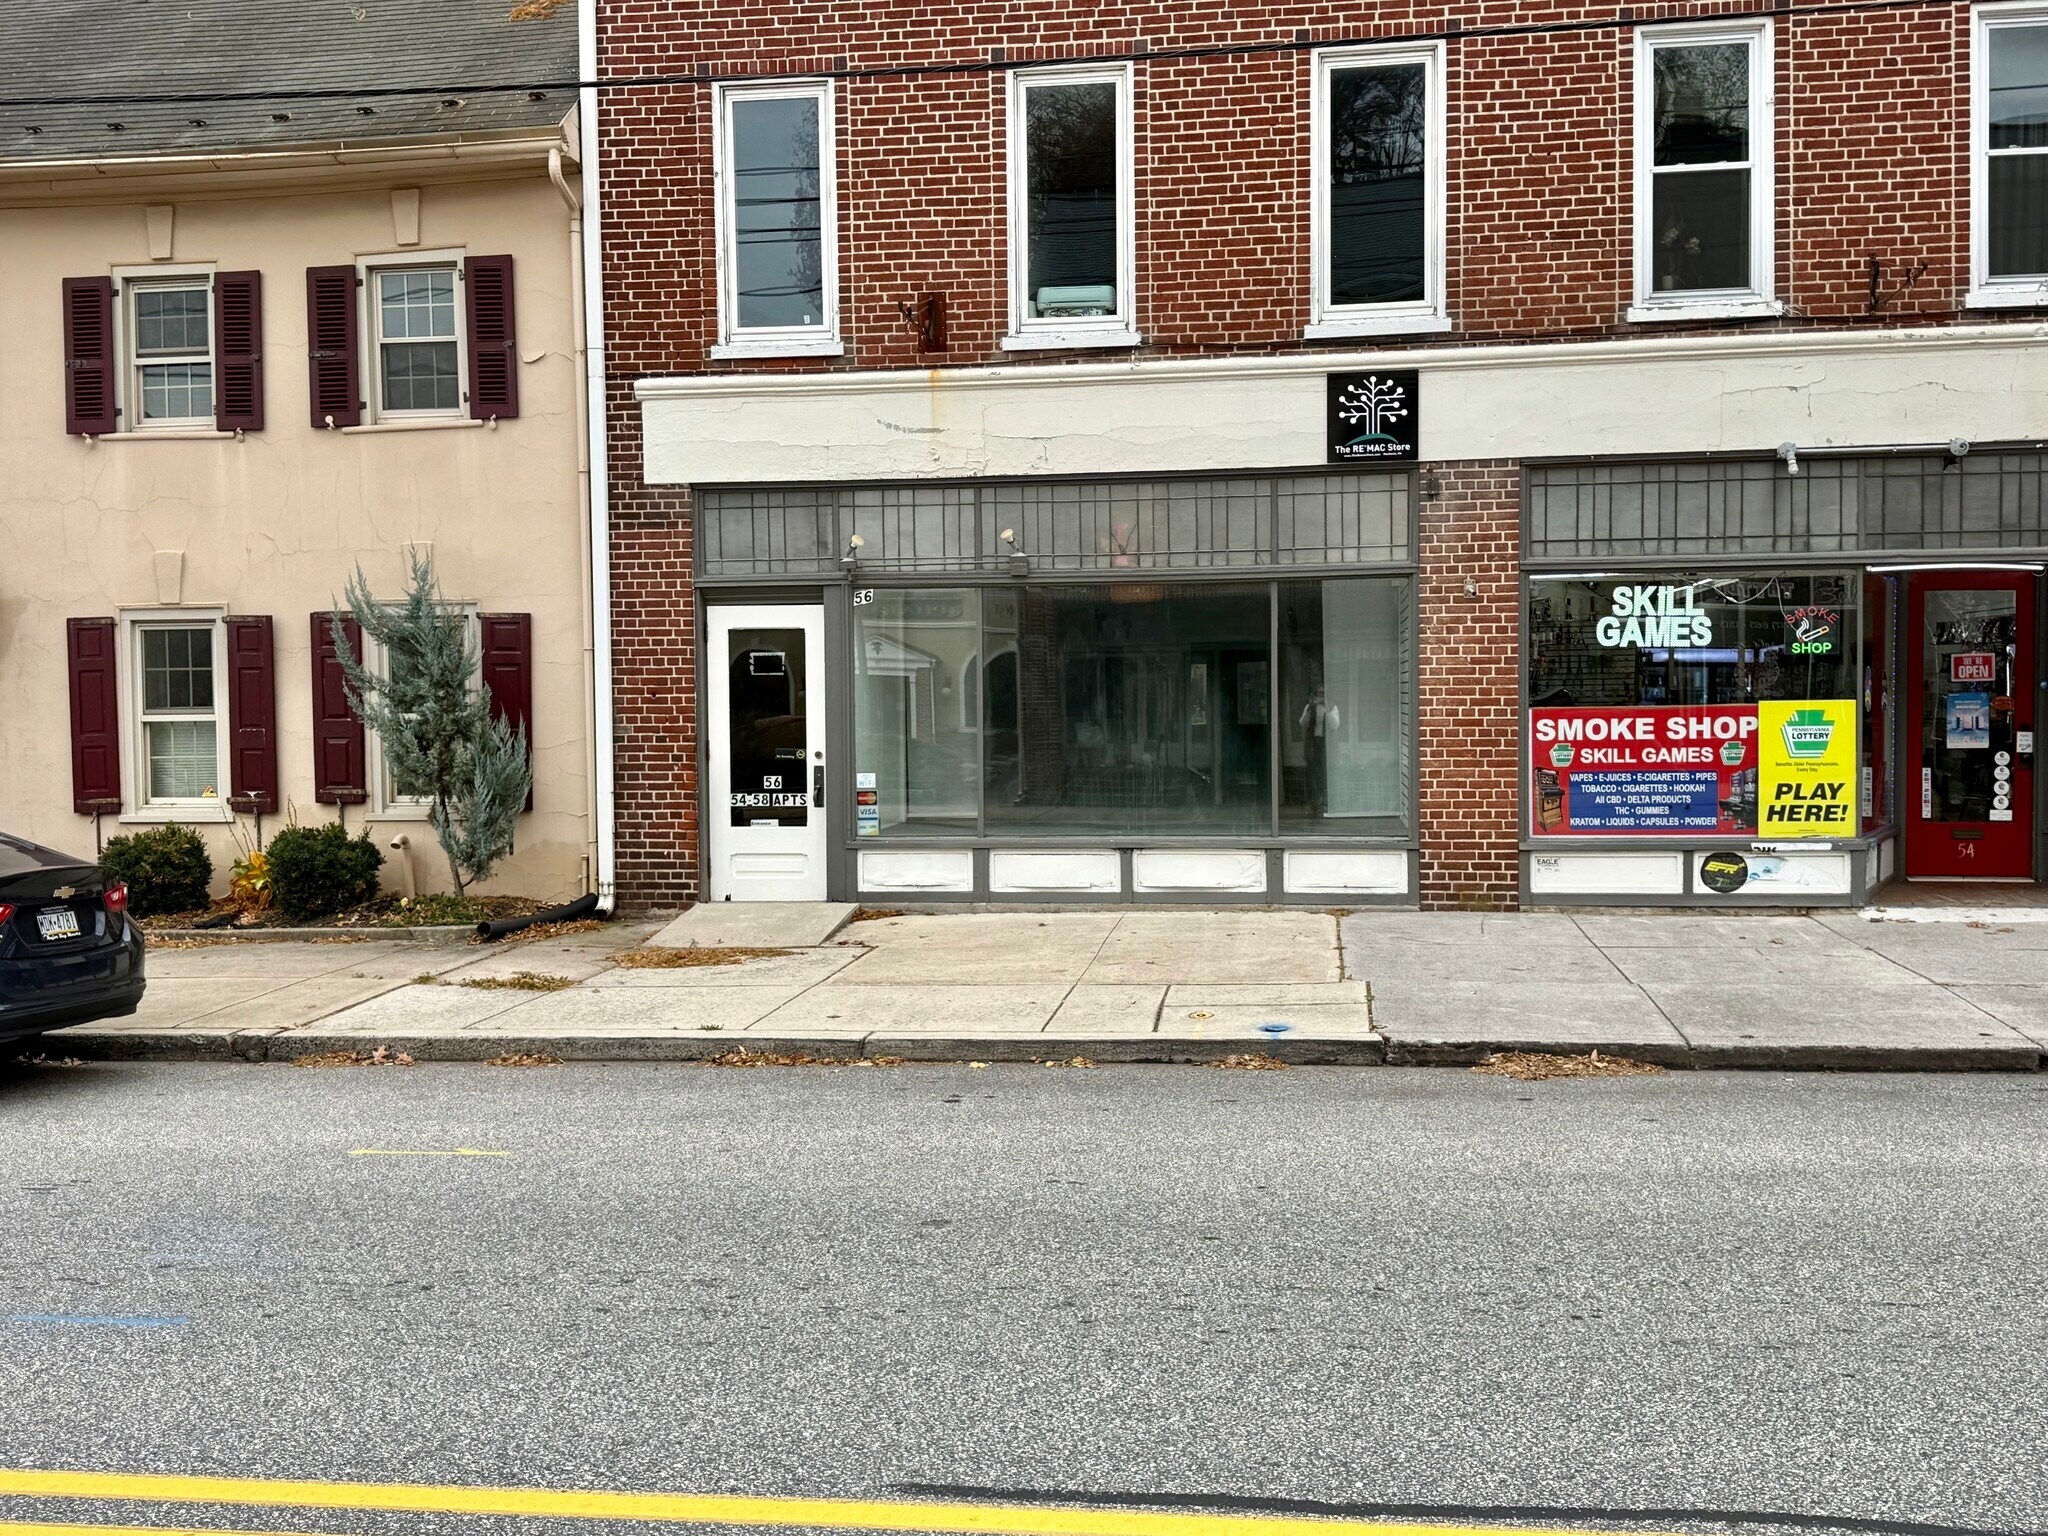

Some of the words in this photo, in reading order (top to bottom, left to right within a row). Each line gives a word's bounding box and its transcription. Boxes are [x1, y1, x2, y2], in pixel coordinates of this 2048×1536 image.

[1335, 445, 1350, 454] The
[1387, 443, 1411, 451] Store
[854, 590, 872, 604] 56
[1612, 585, 1705, 617] SKILL
[1786, 606, 1839, 624] SMOKE
[1596, 616, 1713, 648] GAMES
[1792, 642, 1832, 654] SHOP
[1958, 665, 1989, 678] OPEN
[1536, 717, 1655, 741] SMOKE
[1666, 716, 1758, 740] SHOP
[1791, 732, 1830, 740] LOTTERY
[1580, 748, 1637, 764] SKILL
[1641, 747, 1714, 763] GAMES
[764, 776, 781, 788] 56
[1569, 773, 1594, 782] VAPES
[1598, 773, 1632, 782] E-JUICES
[1637, 772, 1690, 781] E-CIGARETTES
[1695, 772, 1718, 781] PIPES
[1581, 784, 1617, 793] TOBACCO
[1622, 784, 1668, 793] CIGARETTES
[1673, 783, 1706, 792] HOOKAH
[1774, 782, 1846, 801] PLAY
[730, 794, 769, 806] 54-58
[773, 794, 807, 806] APTS
[1606, 795, 1622, 804] CBD
[1627, 795, 1651, 804] DELTA
[1652, 795, 1692, 804] PRODUCTS
[1614, 806, 1630, 815] THC
[1635, 806, 1670, 815] GUMMIES
[1766, 804, 1849, 822] HERE!
[1570, 817, 1601, 826] KRATOM
[1605, 817, 1635, 826] LIQUIDS
[1640, 817, 1680, 826] CAPSULES
[1684, 817, 1718, 826] POWDER
[1957, 842, 1975, 859] 54
